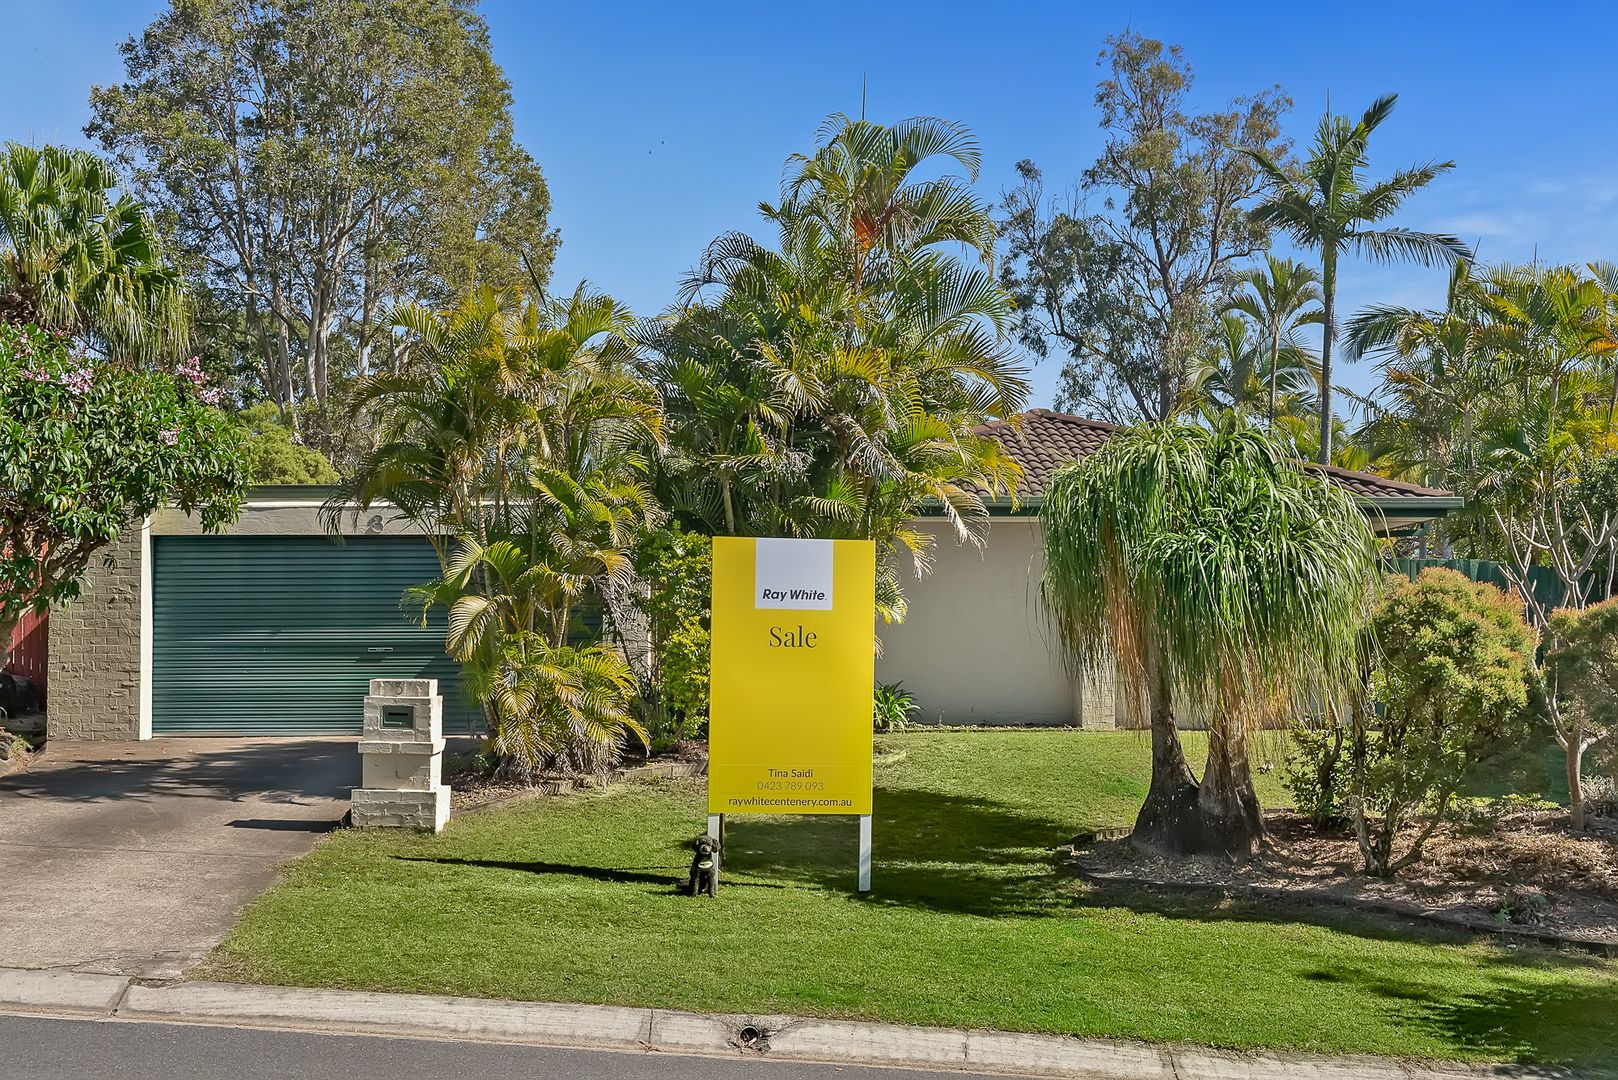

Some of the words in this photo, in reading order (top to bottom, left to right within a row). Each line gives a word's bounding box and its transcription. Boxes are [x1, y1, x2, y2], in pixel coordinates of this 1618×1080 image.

[763, 589, 787, 601] Ray
[790, 590, 825, 600] White
[769, 625, 817, 648] Sale
[768, 768, 788, 778] Tina
[791, 768, 813, 778] Saidi
[757, 781, 782, 791] 0423
[785, 781, 802, 791] 789
[805, 781, 824, 791] 093
[728, 796, 852, 807] raywhitecentenery.com.au
